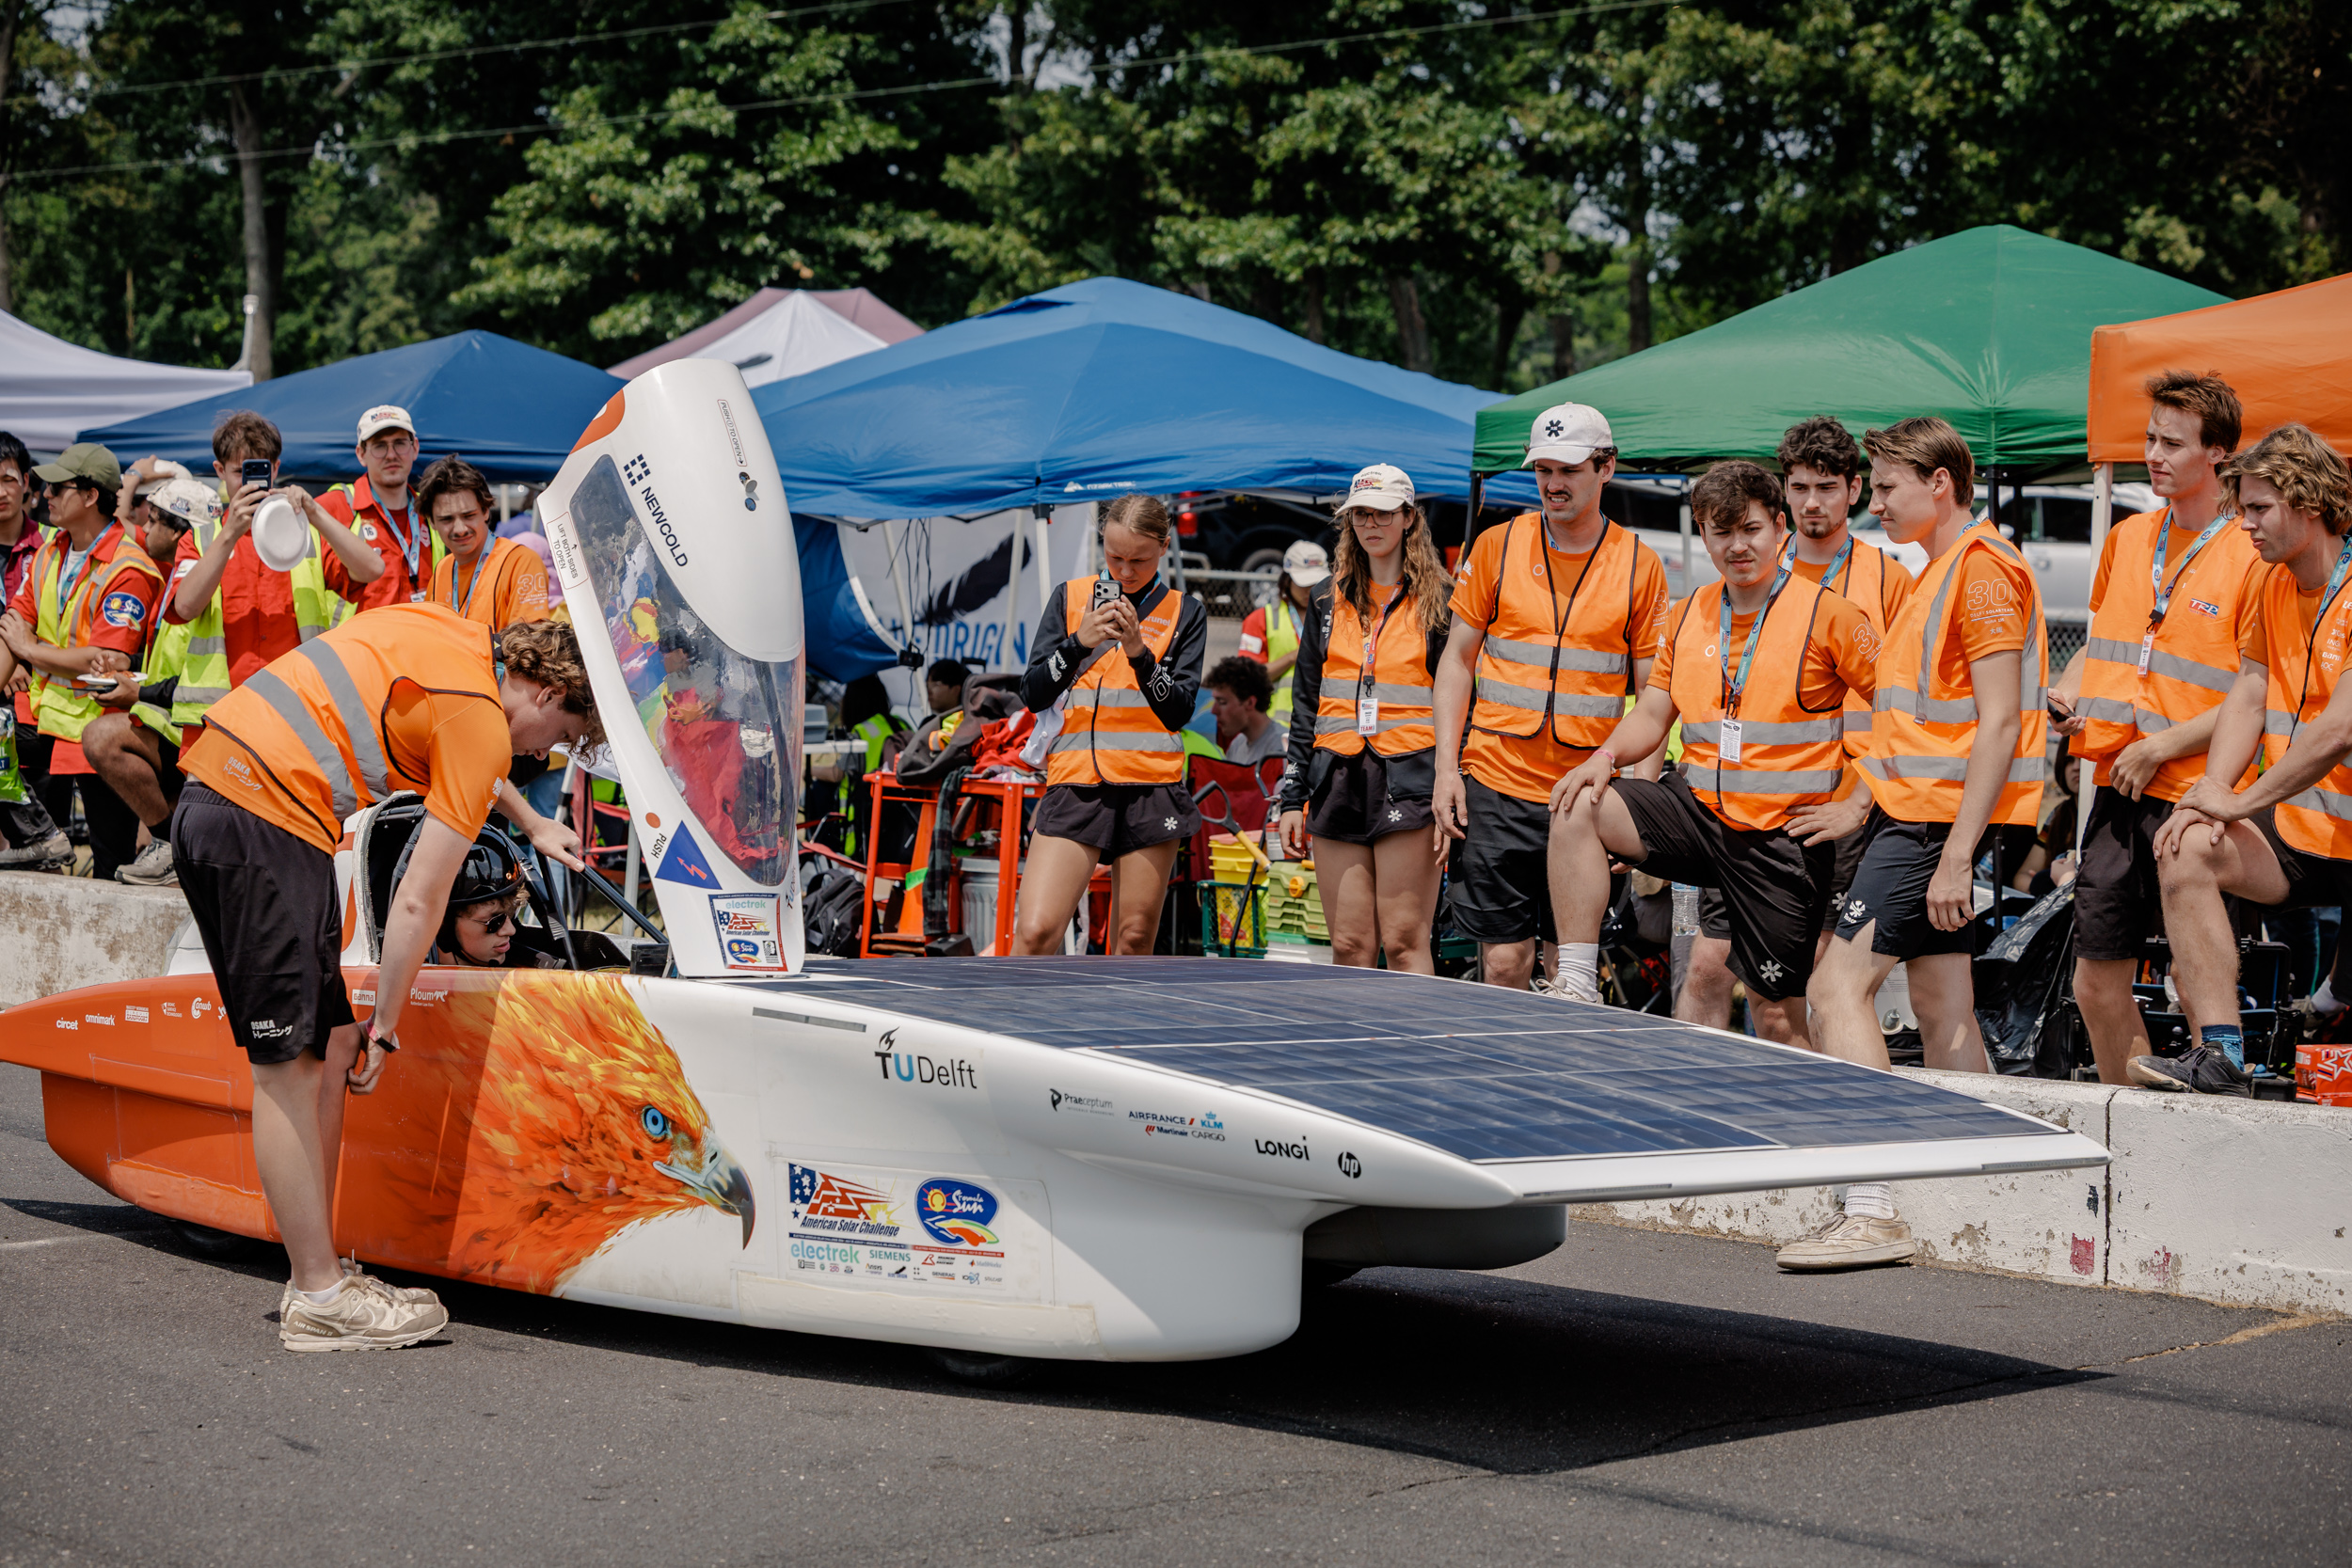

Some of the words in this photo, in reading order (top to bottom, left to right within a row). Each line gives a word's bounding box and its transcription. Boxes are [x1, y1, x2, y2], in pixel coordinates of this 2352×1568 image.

[642, 486, 688, 567] NEWCOLD
[553, 539, 561, 549] TO
[557, 523, 566, 538] LIFT
[562, 538, 572, 558] BOTH
[567, 558, 579, 578] SIDES
[556, 550, 566, 570] OPEN
[1967, 578, 2012, 610] 30
[228, 756, 251, 776] OSAKA
[223, 764, 262, 790] トレーニング
[651, 833, 667, 859] PUSH
[725, 899, 766, 910] electrek
[410, 987, 434, 1001] Ploum
[195, 1001, 212, 1011] anwb
[56, 1017, 78, 1030] circet
[86, 1013, 115, 1026] omnimark
[250, 1019, 276, 1030] OSAKA
[252, 1025, 293, 1038] トレーニング
[1064, 1093, 1113, 1109] Praeceptum
[1200, 1119, 1224, 1130] KLM
[1156, 1126, 1188, 1136] Martinair
[1191, 1130, 1226, 1142] CARGO
[1340, 1151, 1360, 1179] hp
[951, 1189, 985, 1214] Sun
[959, 1193, 984, 1203] Formula
[800, 1215, 837, 1230] American
[838, 1219, 859, 1233] Solar
[859, 1221, 900, 1237] Challenge
[790, 1240, 860, 1263] electrek
[869, 1249, 912, 1262] SIEMENS
[294, 1321, 307, 1329] AIR
[306, 1325, 326, 1336] SPAN
